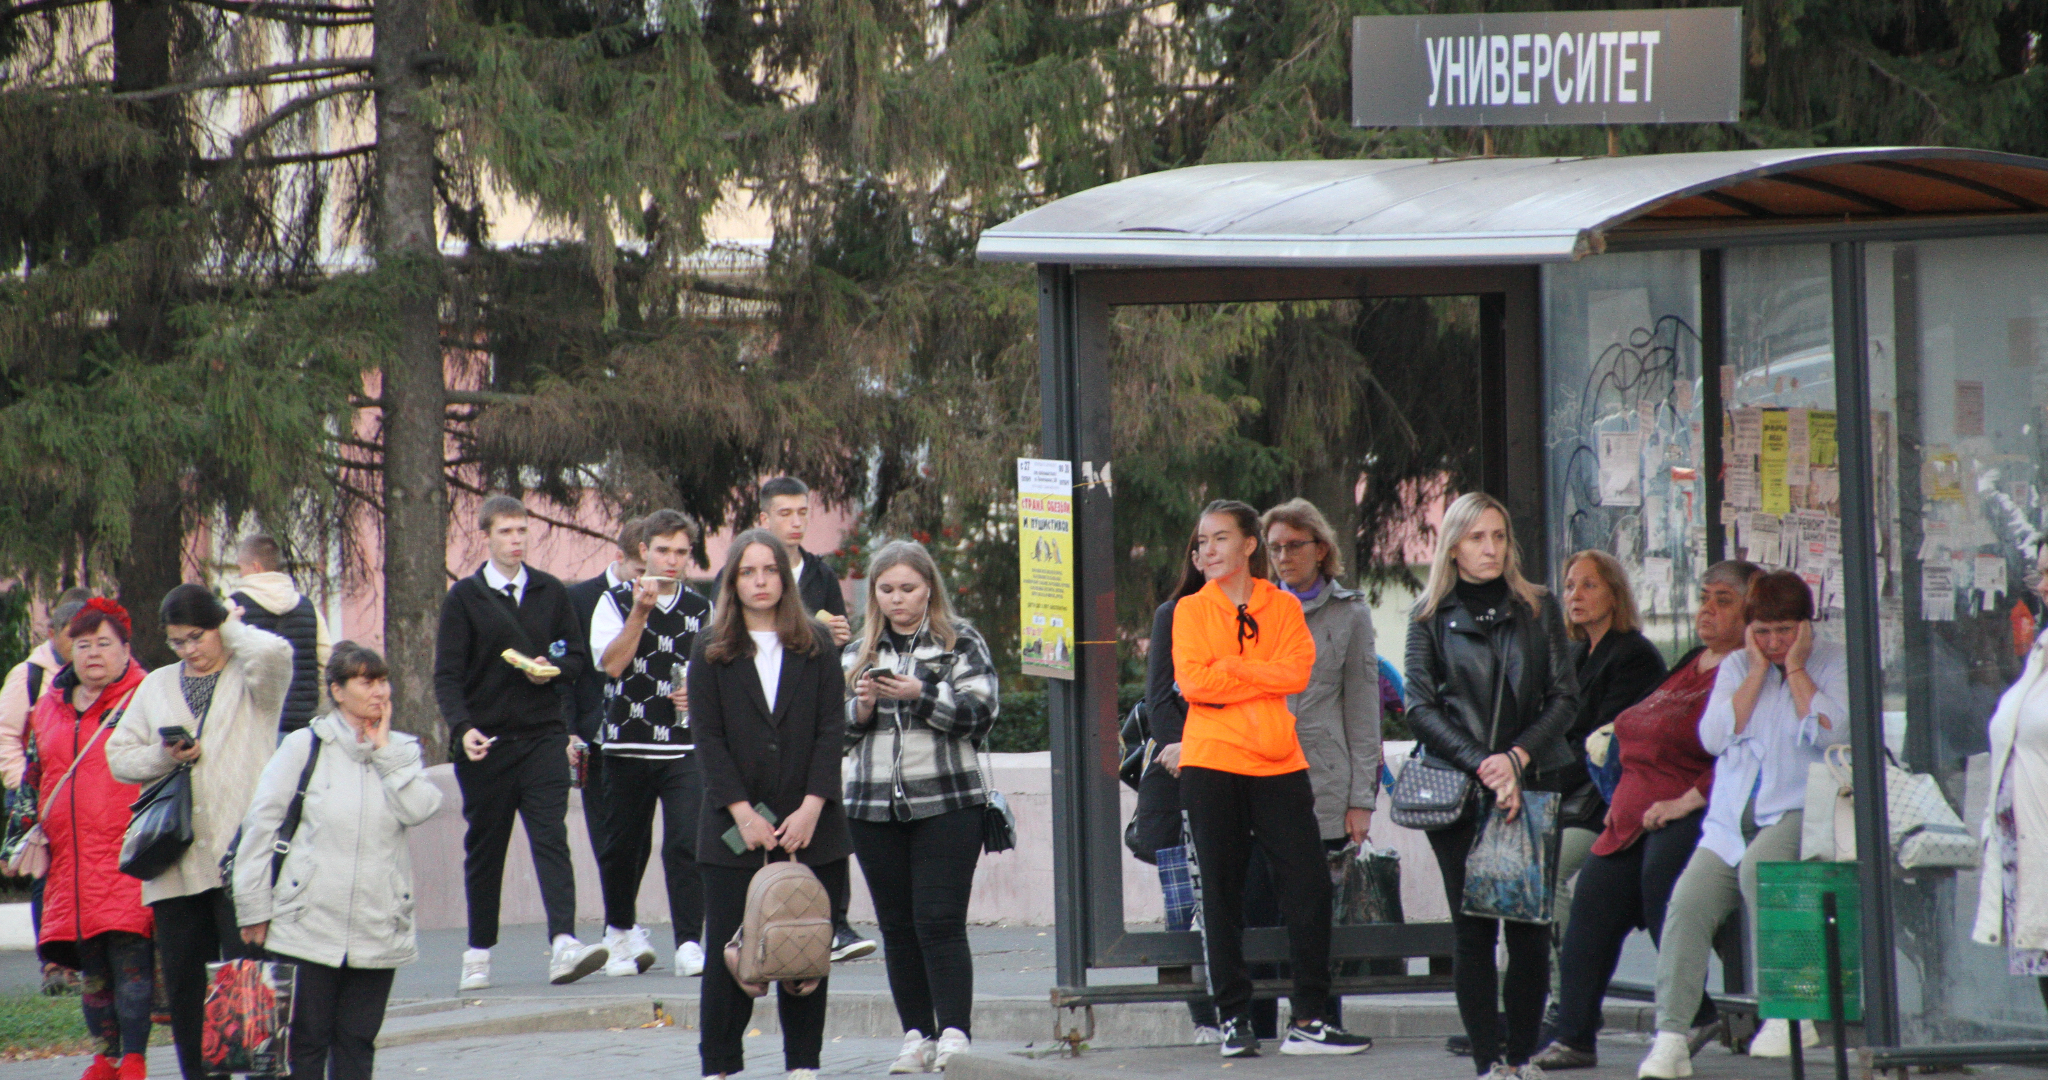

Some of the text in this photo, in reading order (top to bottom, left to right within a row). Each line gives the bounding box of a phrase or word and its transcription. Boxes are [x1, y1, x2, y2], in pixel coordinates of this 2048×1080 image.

[1426, 31, 1660, 107] УНИВЕРСИТЕТ
[1022, 497, 1044, 511] СТРАНА
[1023, 516, 1028, 528] И
